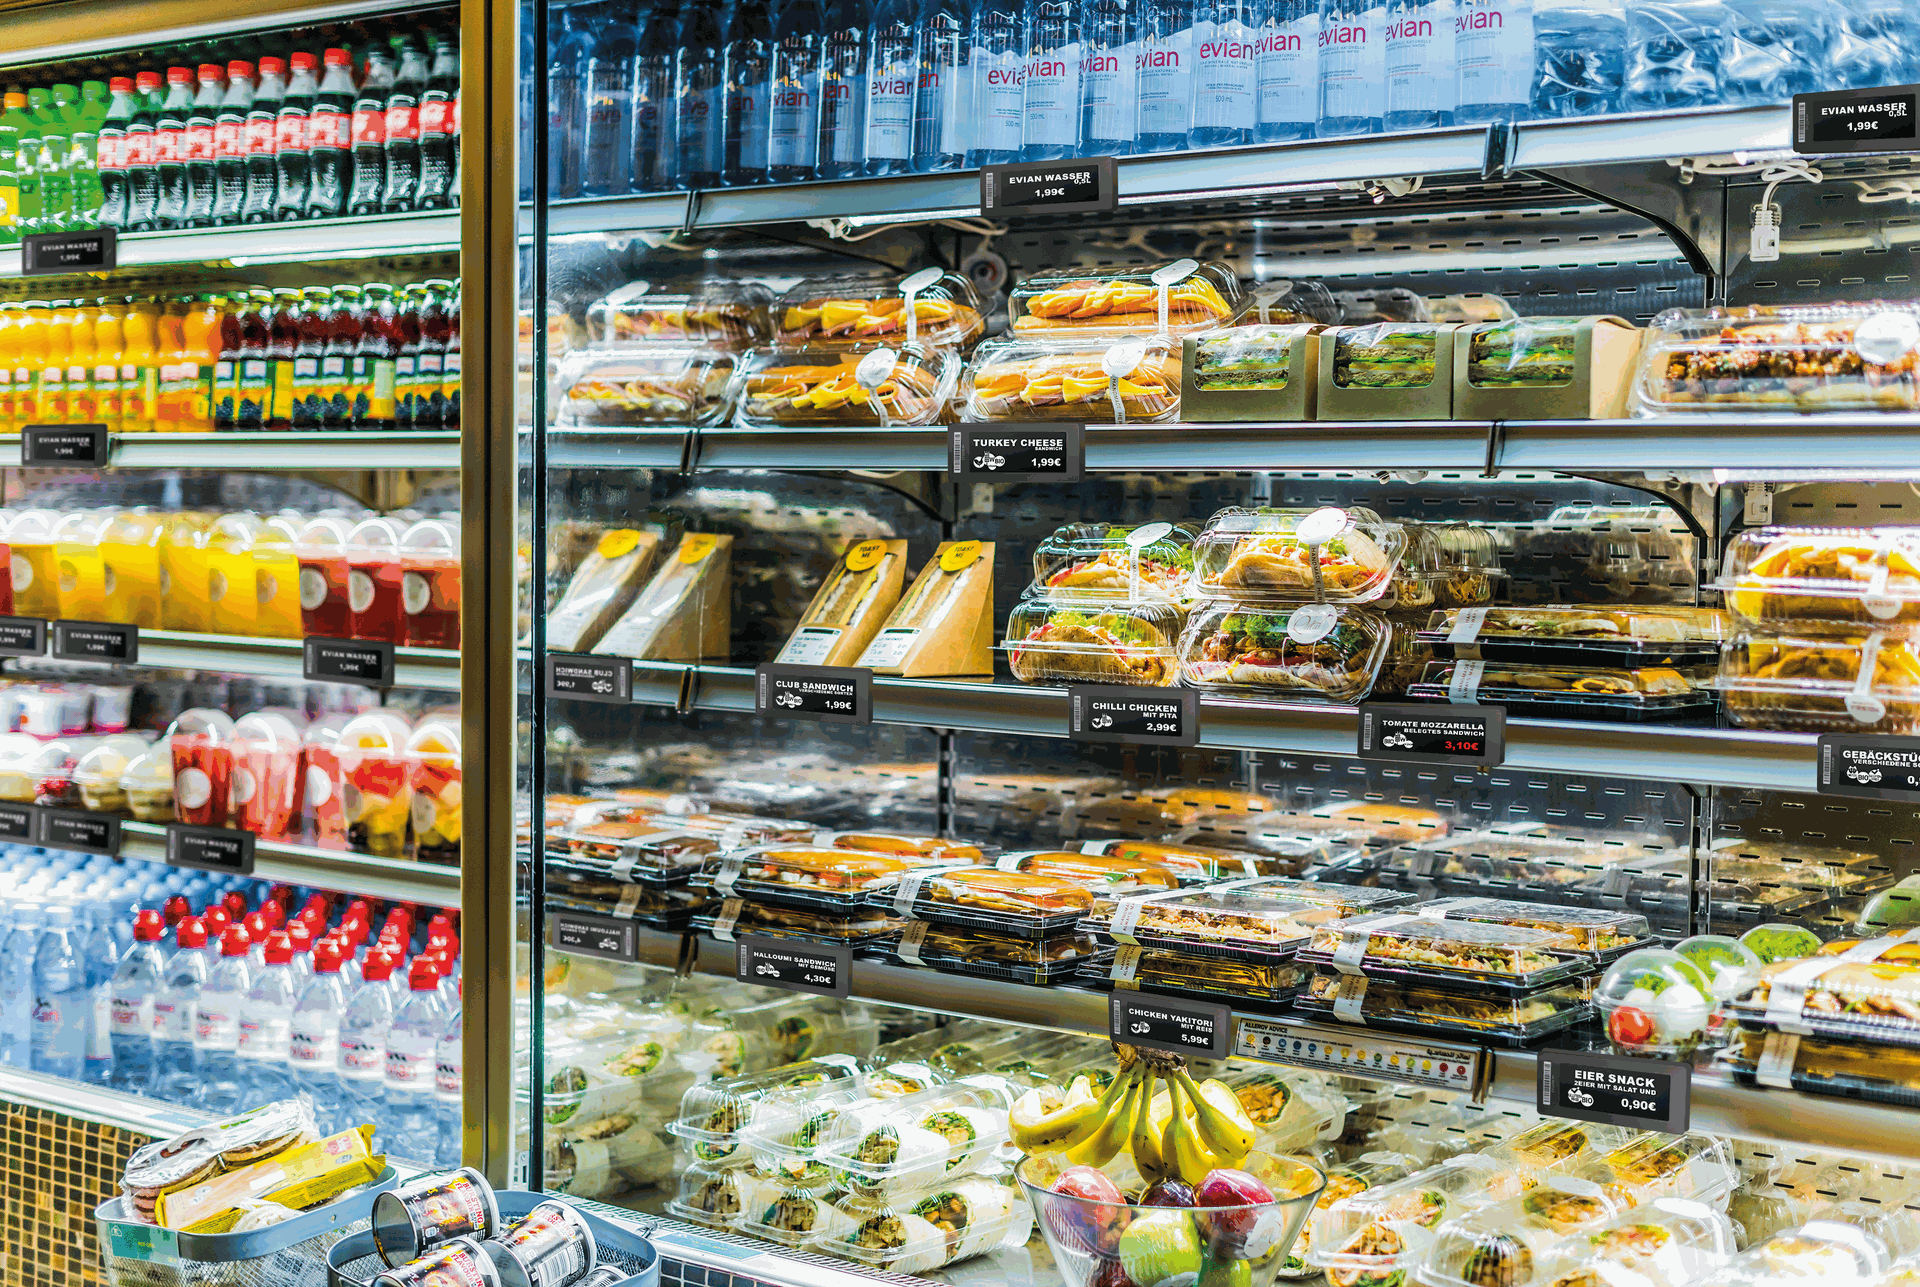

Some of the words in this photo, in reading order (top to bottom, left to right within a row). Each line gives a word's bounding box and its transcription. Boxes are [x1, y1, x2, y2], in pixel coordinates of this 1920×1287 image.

[1455, 10, 1502, 34] evian
[1318, 24, 1366, 47] evian
[1385, 18, 1432, 42] evian
[1200, 38, 1254, 60] evian
[1255, 32, 1300, 55] evian
[1135, 49, 1179, 70] evian
[1021, 59, 1066, 80] evian
[1215, 95, 1225, 103] 500
[1821, 105, 1855, 116] EVIAN
[1857, 102, 1907, 113] WASSER
[1888, 110, 1908, 118] 0,5L
[1846, 121, 1879, 133] 1,99€
[1009, 175, 1042, 184] EVIAN
[1044, 171, 1091, 181] WASSER
[1034, 187, 1065, 198] 1,99€
[972, 438, 1018, 447] TURKEY
[1020, 438, 1063, 447] CHEESE
[1031, 457, 1061, 468] 1,99€
[1311, 547, 1322, 585] HANDMADE
[321, 650, 345, 658] EVIAN
[775, 680, 800, 689] CLUB
[802, 682, 854, 692] SANDWICH
[824, 700, 852, 710] 1,99€
[1092, 702, 1126, 711] CHILLI
[1129, 703, 1178, 713] CHICKEN
[1146, 723, 1177, 733] 2,99€
[1382, 720, 1419, 728] TOMATE
[1420, 721, 1484, 731] MOZZARELLA
[1403, 727, 1441, 735] BELEGTES
[1443, 729, 1485, 737] SANDWICH
[1445, 741, 1479, 751] 3,10€
[1842, 749, 1920, 763] GEBÄCKSTÜ
[1853, 758, 1911, 768] VERSCHIEDENE
[753, 951, 792, 962] HALLOUMI
[794, 956, 836, 968] SANDWICH
[804, 973, 831, 984] 4,30€
[1128, 1008, 1168, 1020] CHICKEN
[1170, 1015, 1213, 1028] YAKITORI
[1196, 1025, 1213, 1034] REIS
[1244, 1022, 1268, 1031] ALLERGY
[1268, 1025, 1288, 1034] ADVICE
[1181, 1033, 1209, 1045] 5,99€
[1574, 1069, 1605, 1083] EIER
[1608, 1073, 1655, 1088] SNACK
[1613, 1085, 1637, 1094] SALAT
[1639, 1088, 1657, 1096] UND
[1621, 1098, 1657, 1112] 0,90€
[462, 1182, 484, 1224] BURSTING
[459, 1252, 484, 1287] BURSTIN
